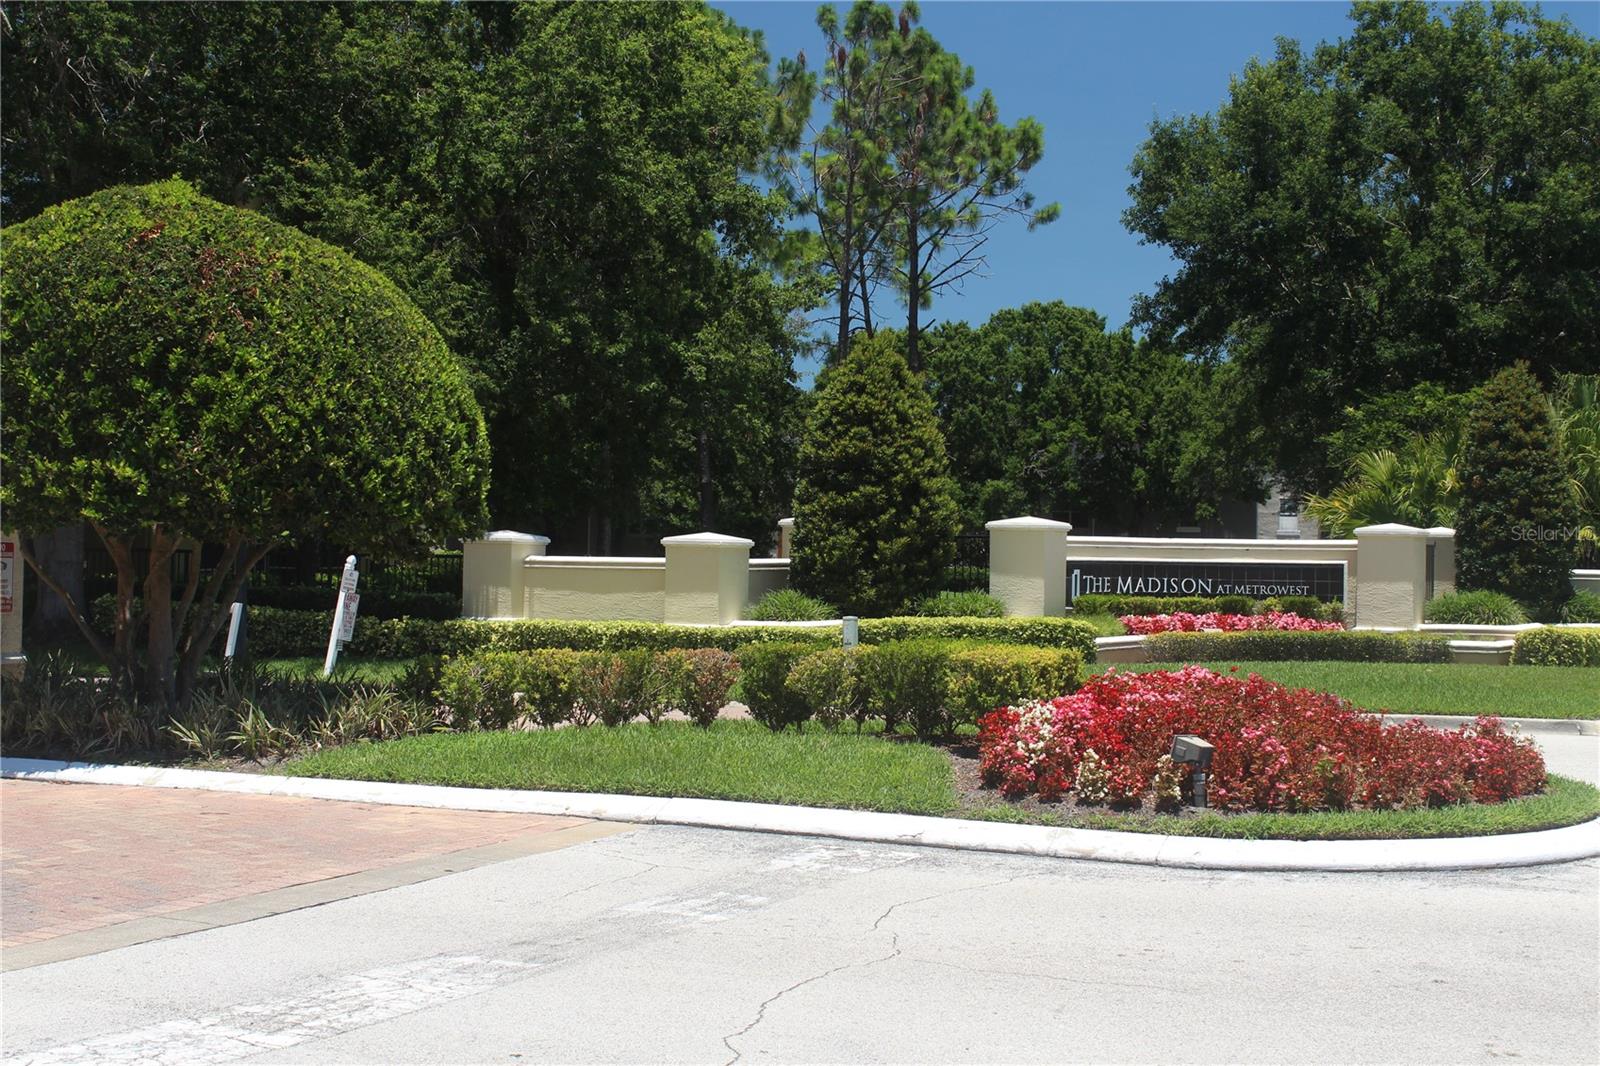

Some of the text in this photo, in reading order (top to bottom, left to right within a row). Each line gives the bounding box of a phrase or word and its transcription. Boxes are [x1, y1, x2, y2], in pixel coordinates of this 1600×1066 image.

[1083, 575, 1310, 595] THE MADISON AT METROWEST
